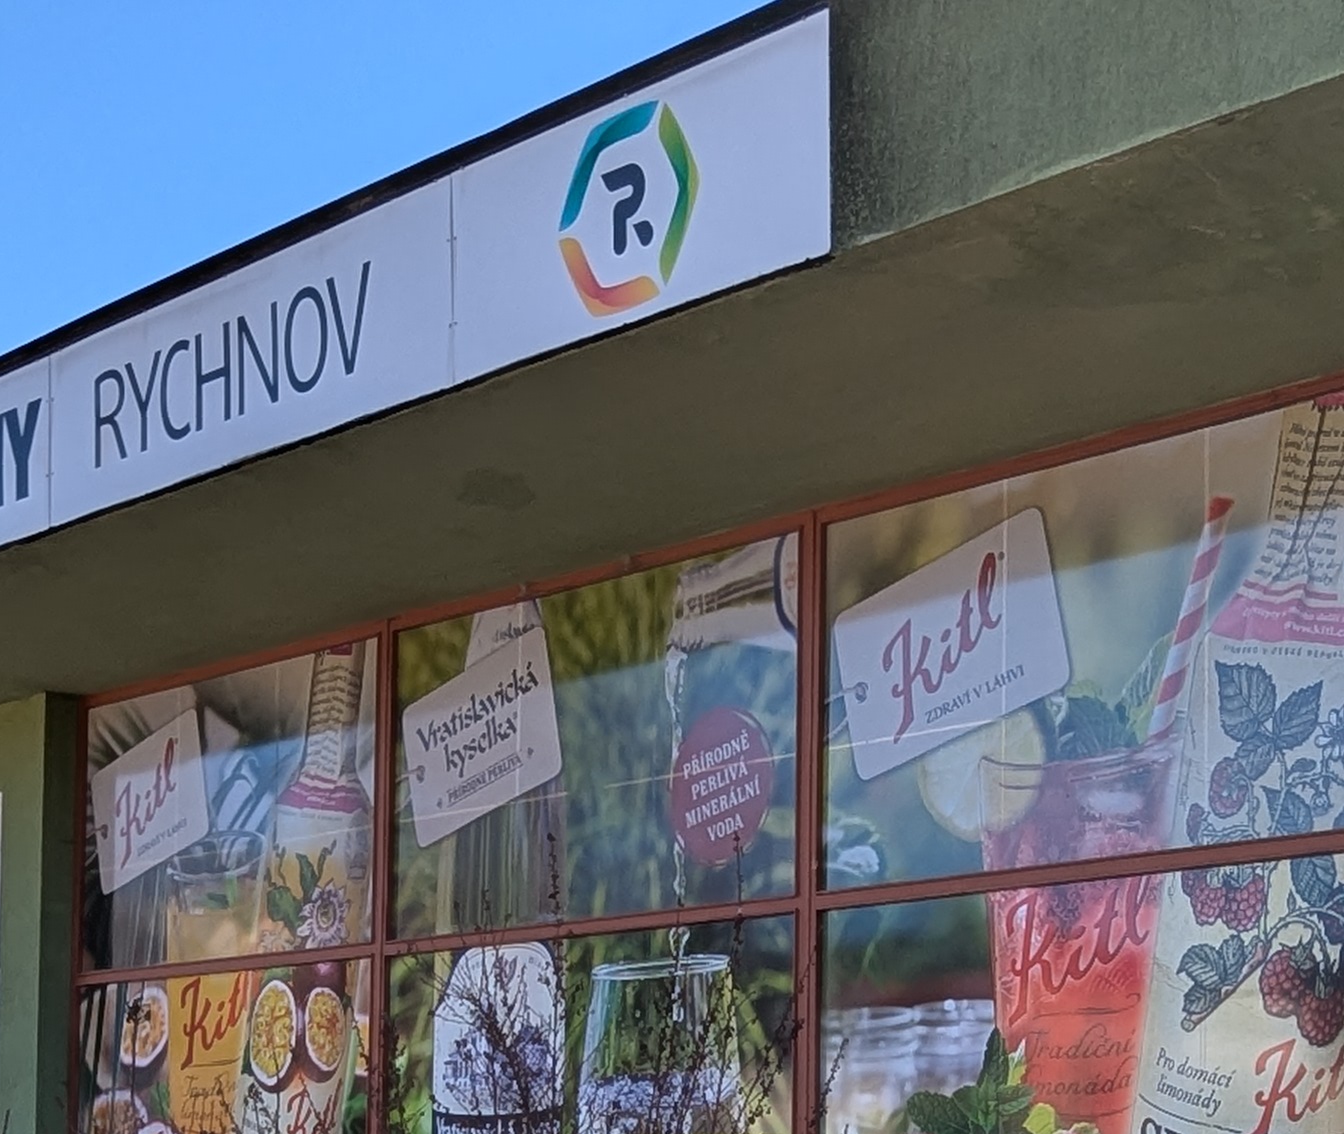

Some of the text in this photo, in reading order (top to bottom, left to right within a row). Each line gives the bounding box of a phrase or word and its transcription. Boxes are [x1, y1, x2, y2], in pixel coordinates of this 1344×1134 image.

[94, 260, 371, 468] RYCHNOV
[882, 552, 1002, 744] Kitl
[416, 661, 540, 753] Vratislavická
[924, 663, 1026, 724] ZDRAVÍ V LÁHVI
[442, 714, 519, 778] kyselka
[682, 728, 751, 780] PŘÍRODNĚ
[116, 737, 176, 870] Kitl
[685, 774, 762, 829] MINERÁLNÍ
[691, 755, 749, 801] PERLIVÁ
[707, 813, 744, 842] VODA
[1006, 876, 1150, 1028] Kitl
[1025, 1023, 1136, 1062] Tradiční
[1155, 1046, 1236, 1089] Pro domácí
[1033, 1055, 1139, 1097] monáda
[1156, 1073, 1222, 1118] limonády
